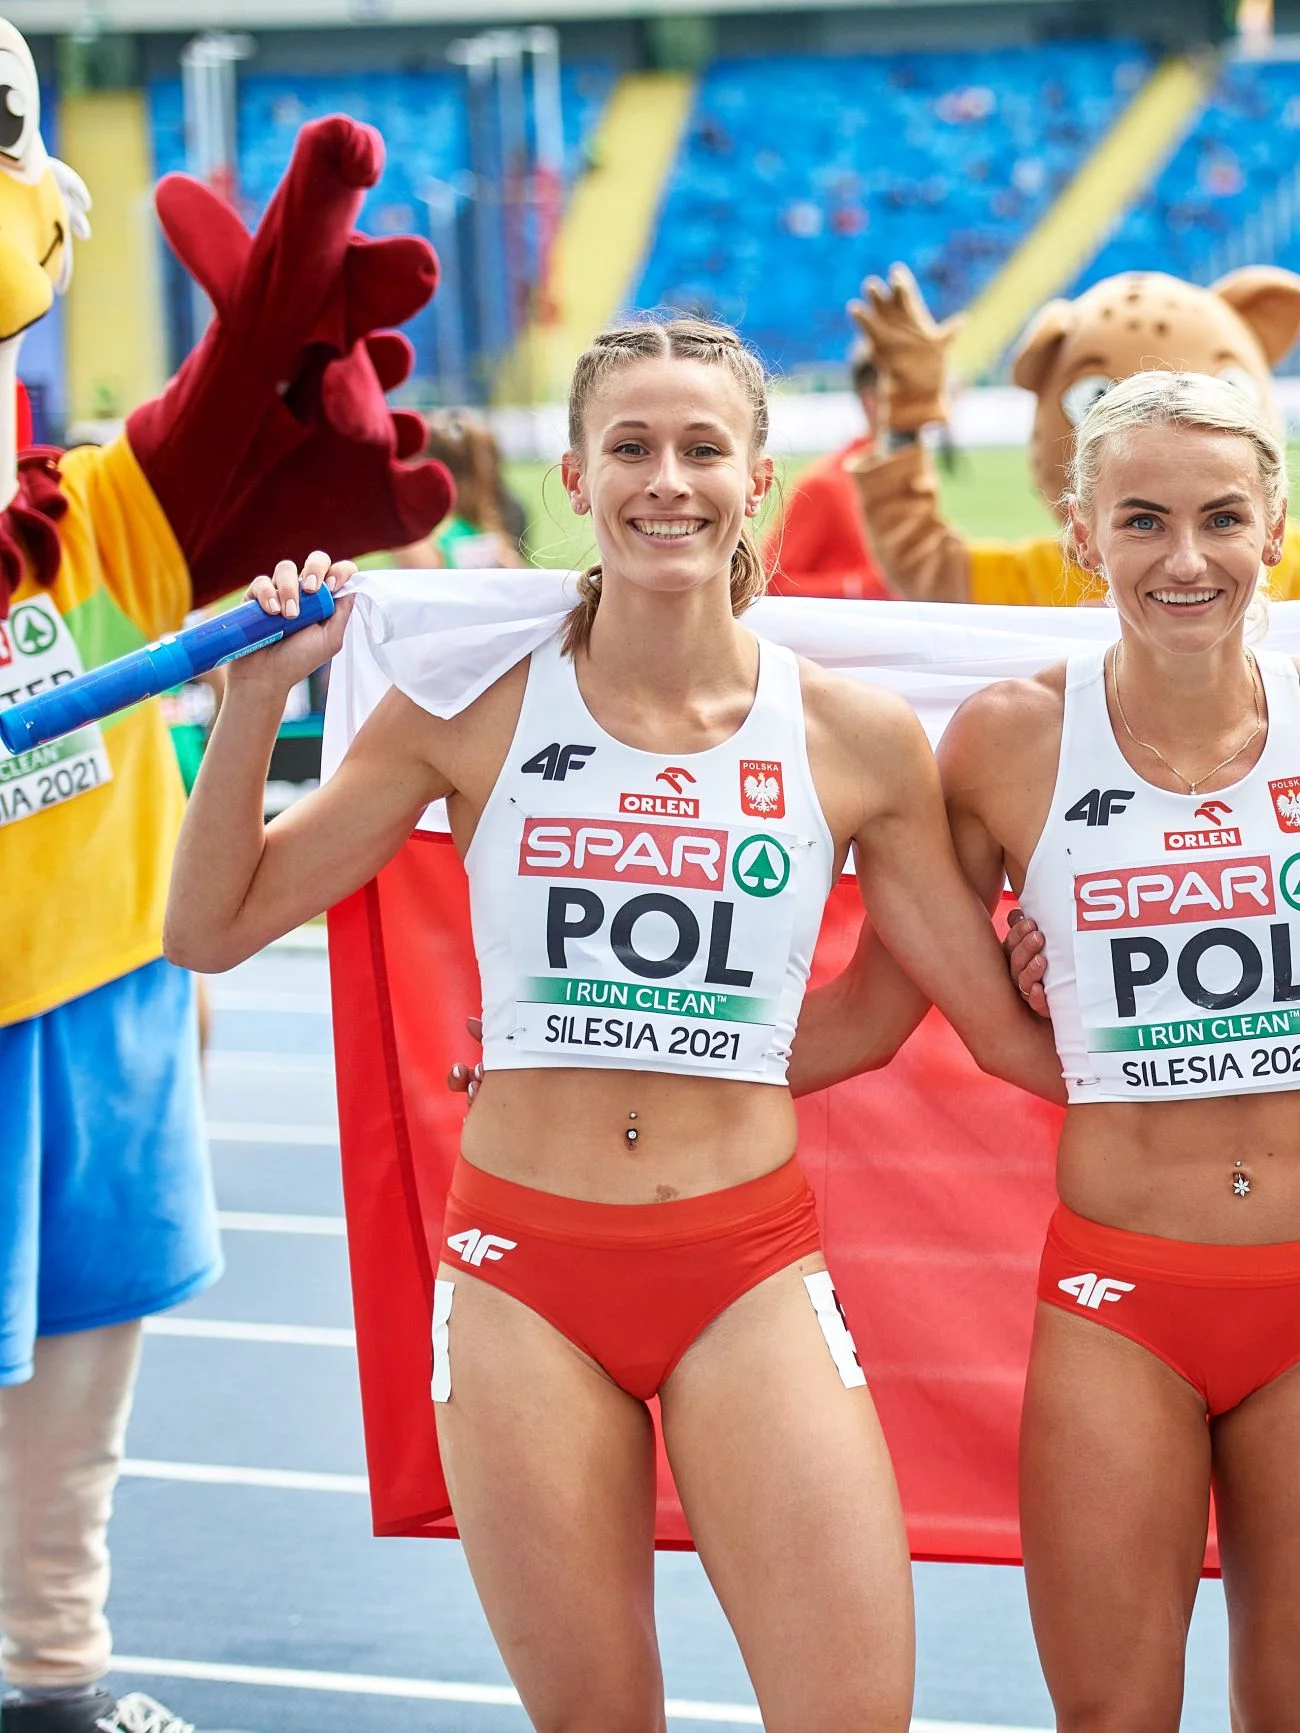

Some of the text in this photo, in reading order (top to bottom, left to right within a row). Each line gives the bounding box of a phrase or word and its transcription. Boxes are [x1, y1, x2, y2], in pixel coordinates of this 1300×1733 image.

[521, 742, 596, 781] 4F
[742, 762, 779, 772] POLSKA
[0, 757, 99, 819] IA 2021
[623, 795, 695, 816] ORLEN
[1064, 789, 1135, 826] 4F
[525, 827, 721, 881] SPAR
[1168, 831, 1237, 848] ORLEN
[1080, 866, 1269, 921] SPAR
[546, 887, 753, 988] POL
[566, 981, 572, 1002] I
[578, 982, 629, 1006] RUN
[545, 1014, 739, 1060] SILESIA 2021
[1138, 1029, 1144, 1046] I
[1151, 1021, 1203, 1044] RUN
[1122, 1053, 1243, 1087] SILESIA
[447, 1228, 518, 1267] 4F
[1057, 1272, 1137, 1309] 4F
